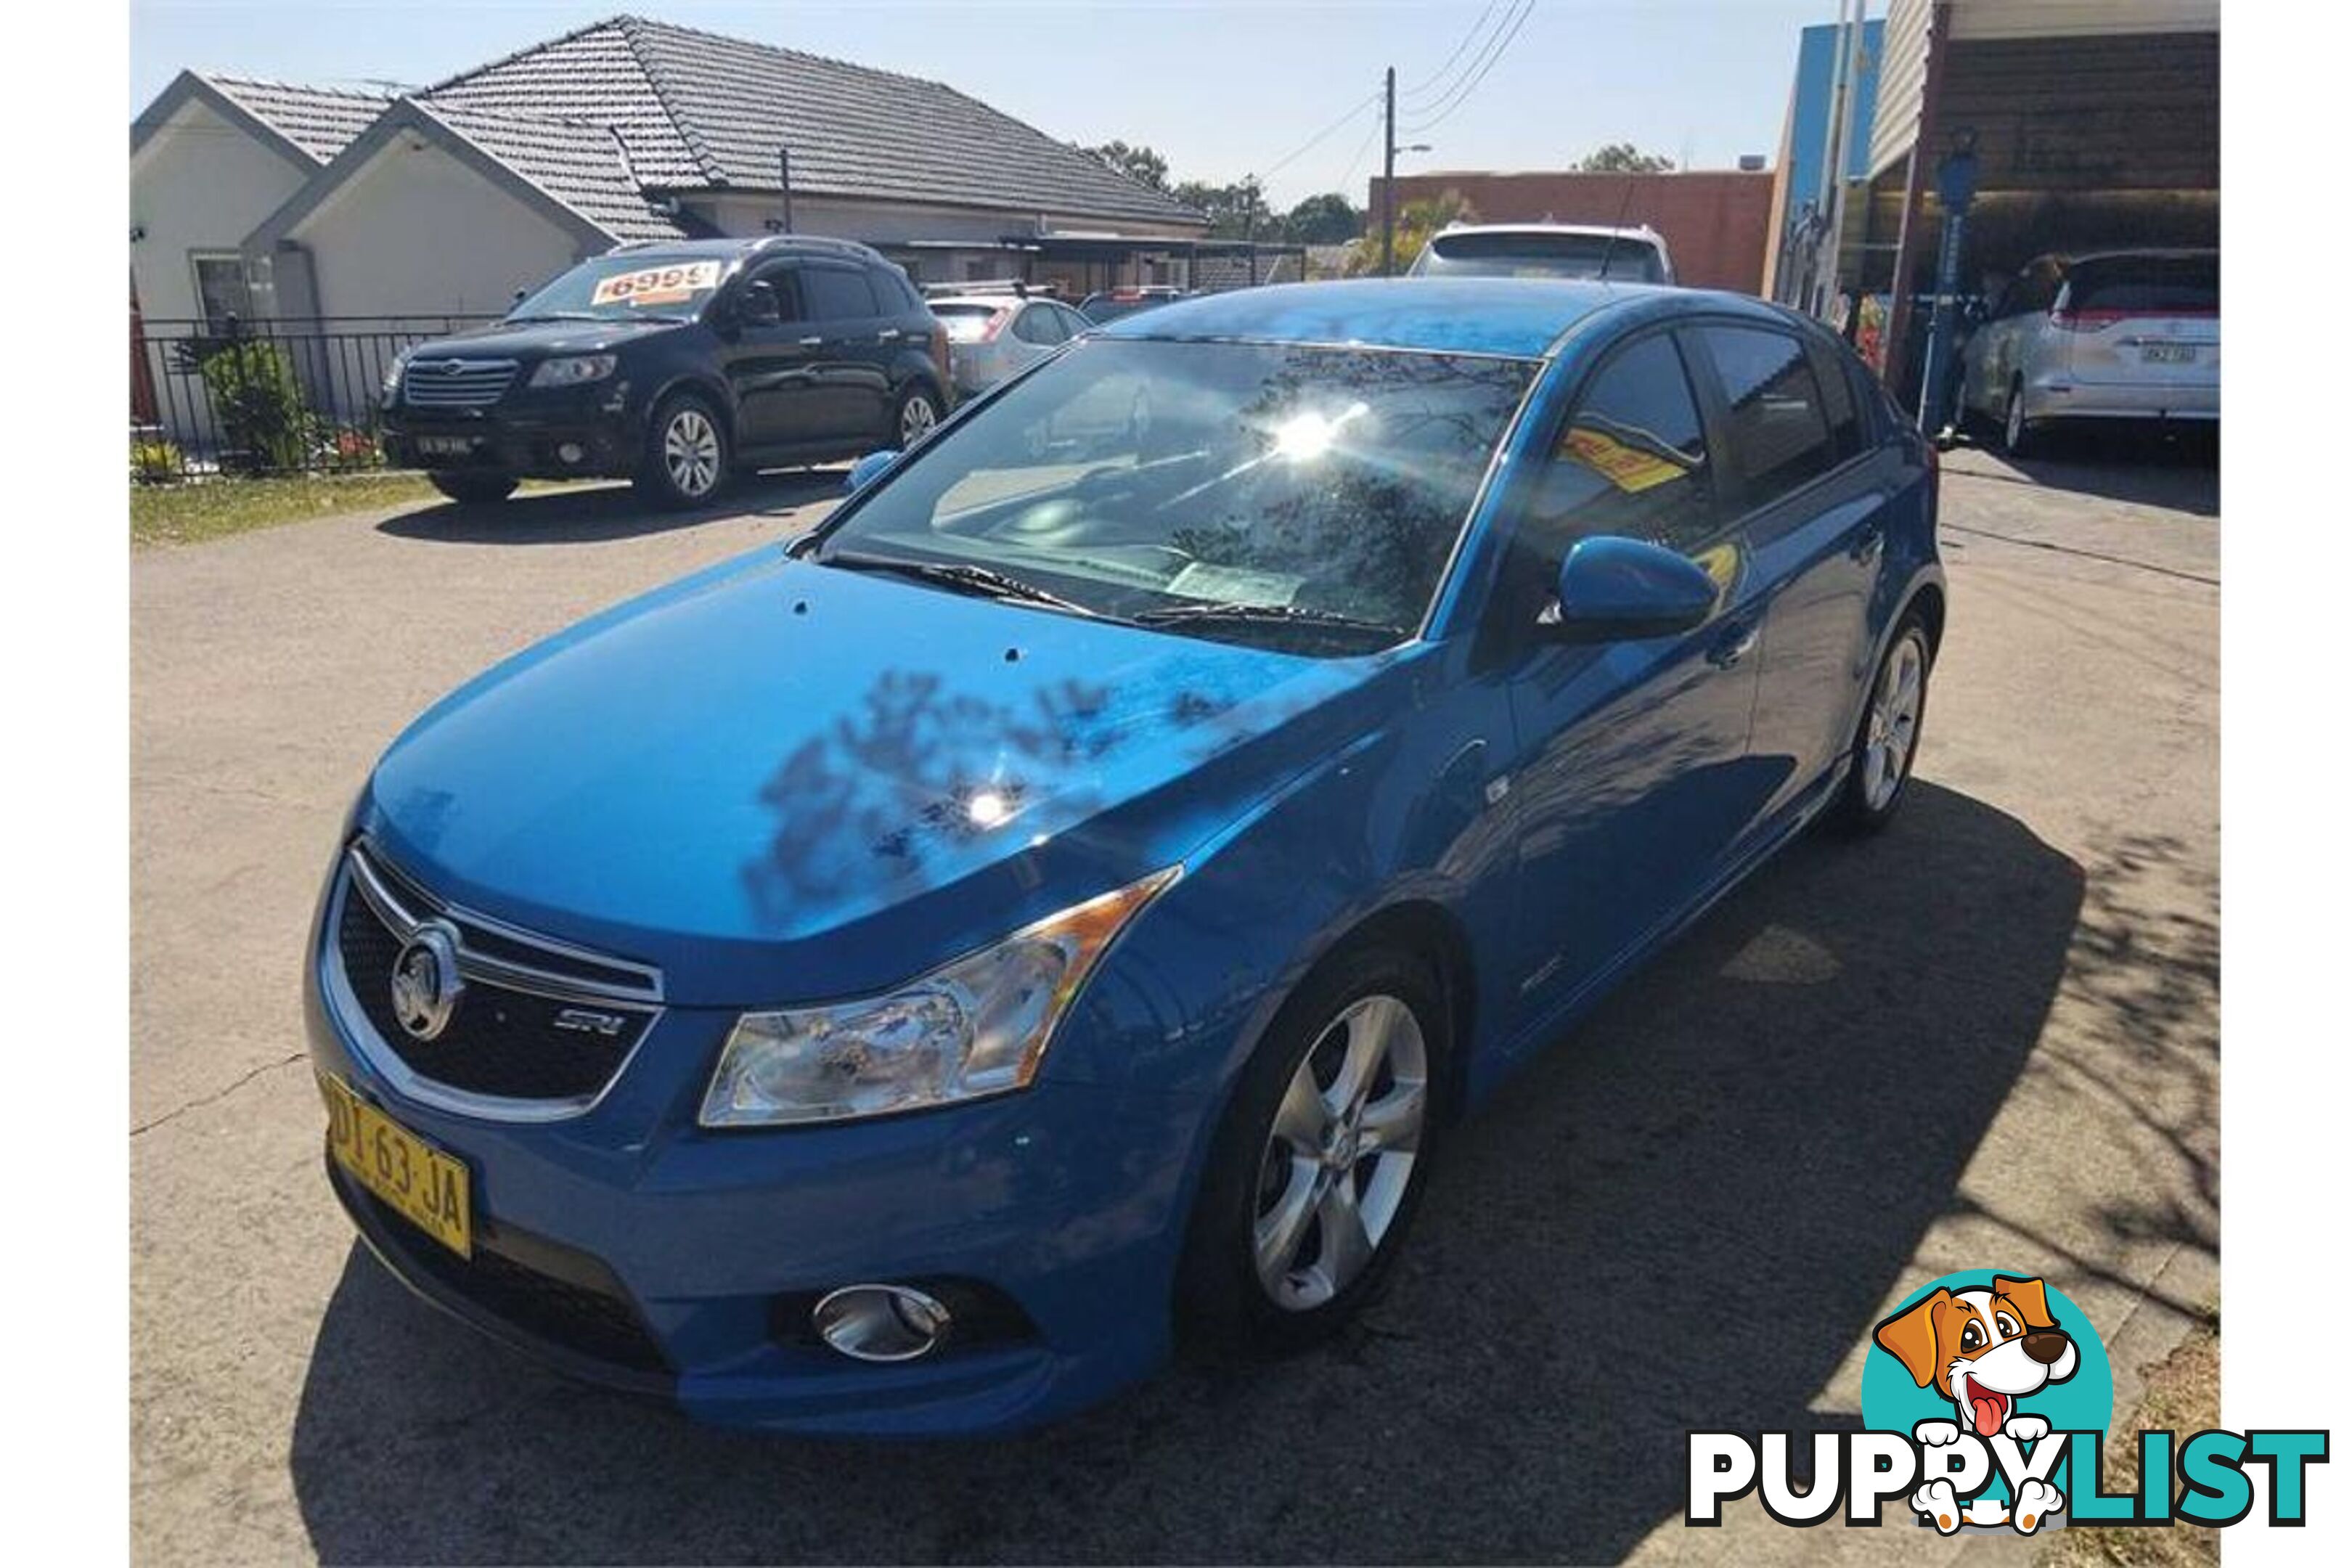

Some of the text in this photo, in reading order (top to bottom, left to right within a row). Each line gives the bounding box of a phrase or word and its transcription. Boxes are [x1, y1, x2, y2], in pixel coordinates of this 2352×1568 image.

[603, 266, 710, 296] 6999
[376, 1125, 411, 1194] 63
[422, 1159, 461, 1232] JA
